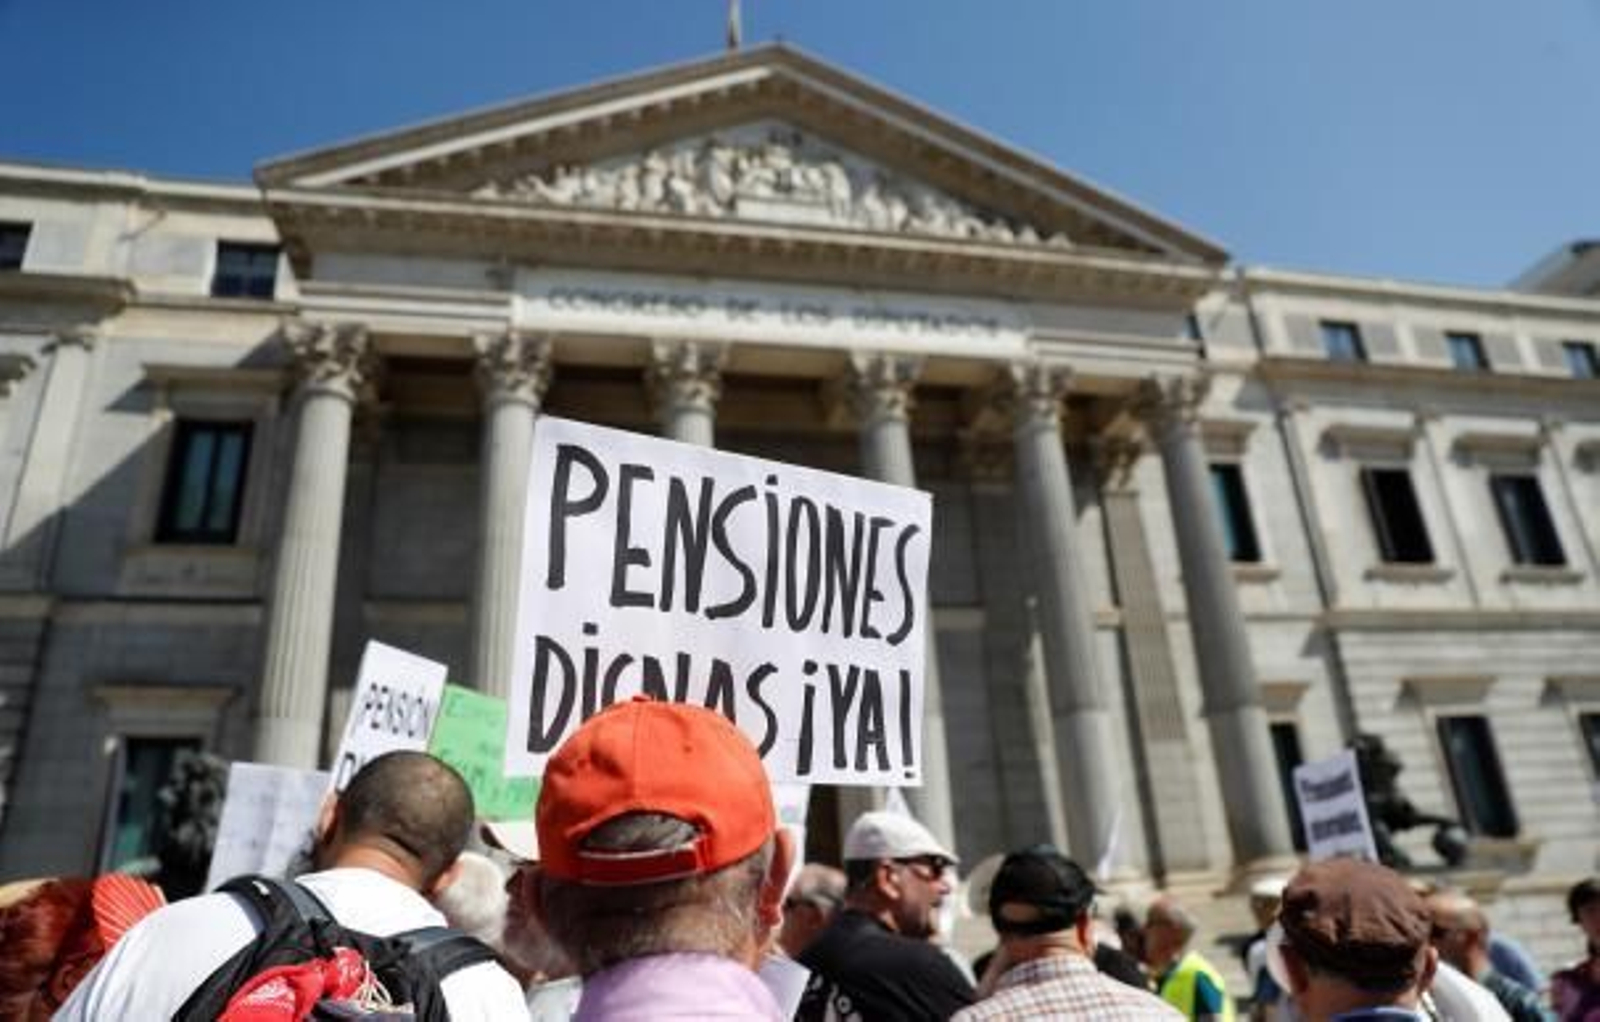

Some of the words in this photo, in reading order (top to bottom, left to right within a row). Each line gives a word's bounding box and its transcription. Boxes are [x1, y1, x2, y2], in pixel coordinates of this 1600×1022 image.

[547, 286, 707, 318] CONGRESO
[725, 294, 761, 321] DE
[780, 300, 831, 328] LOS
